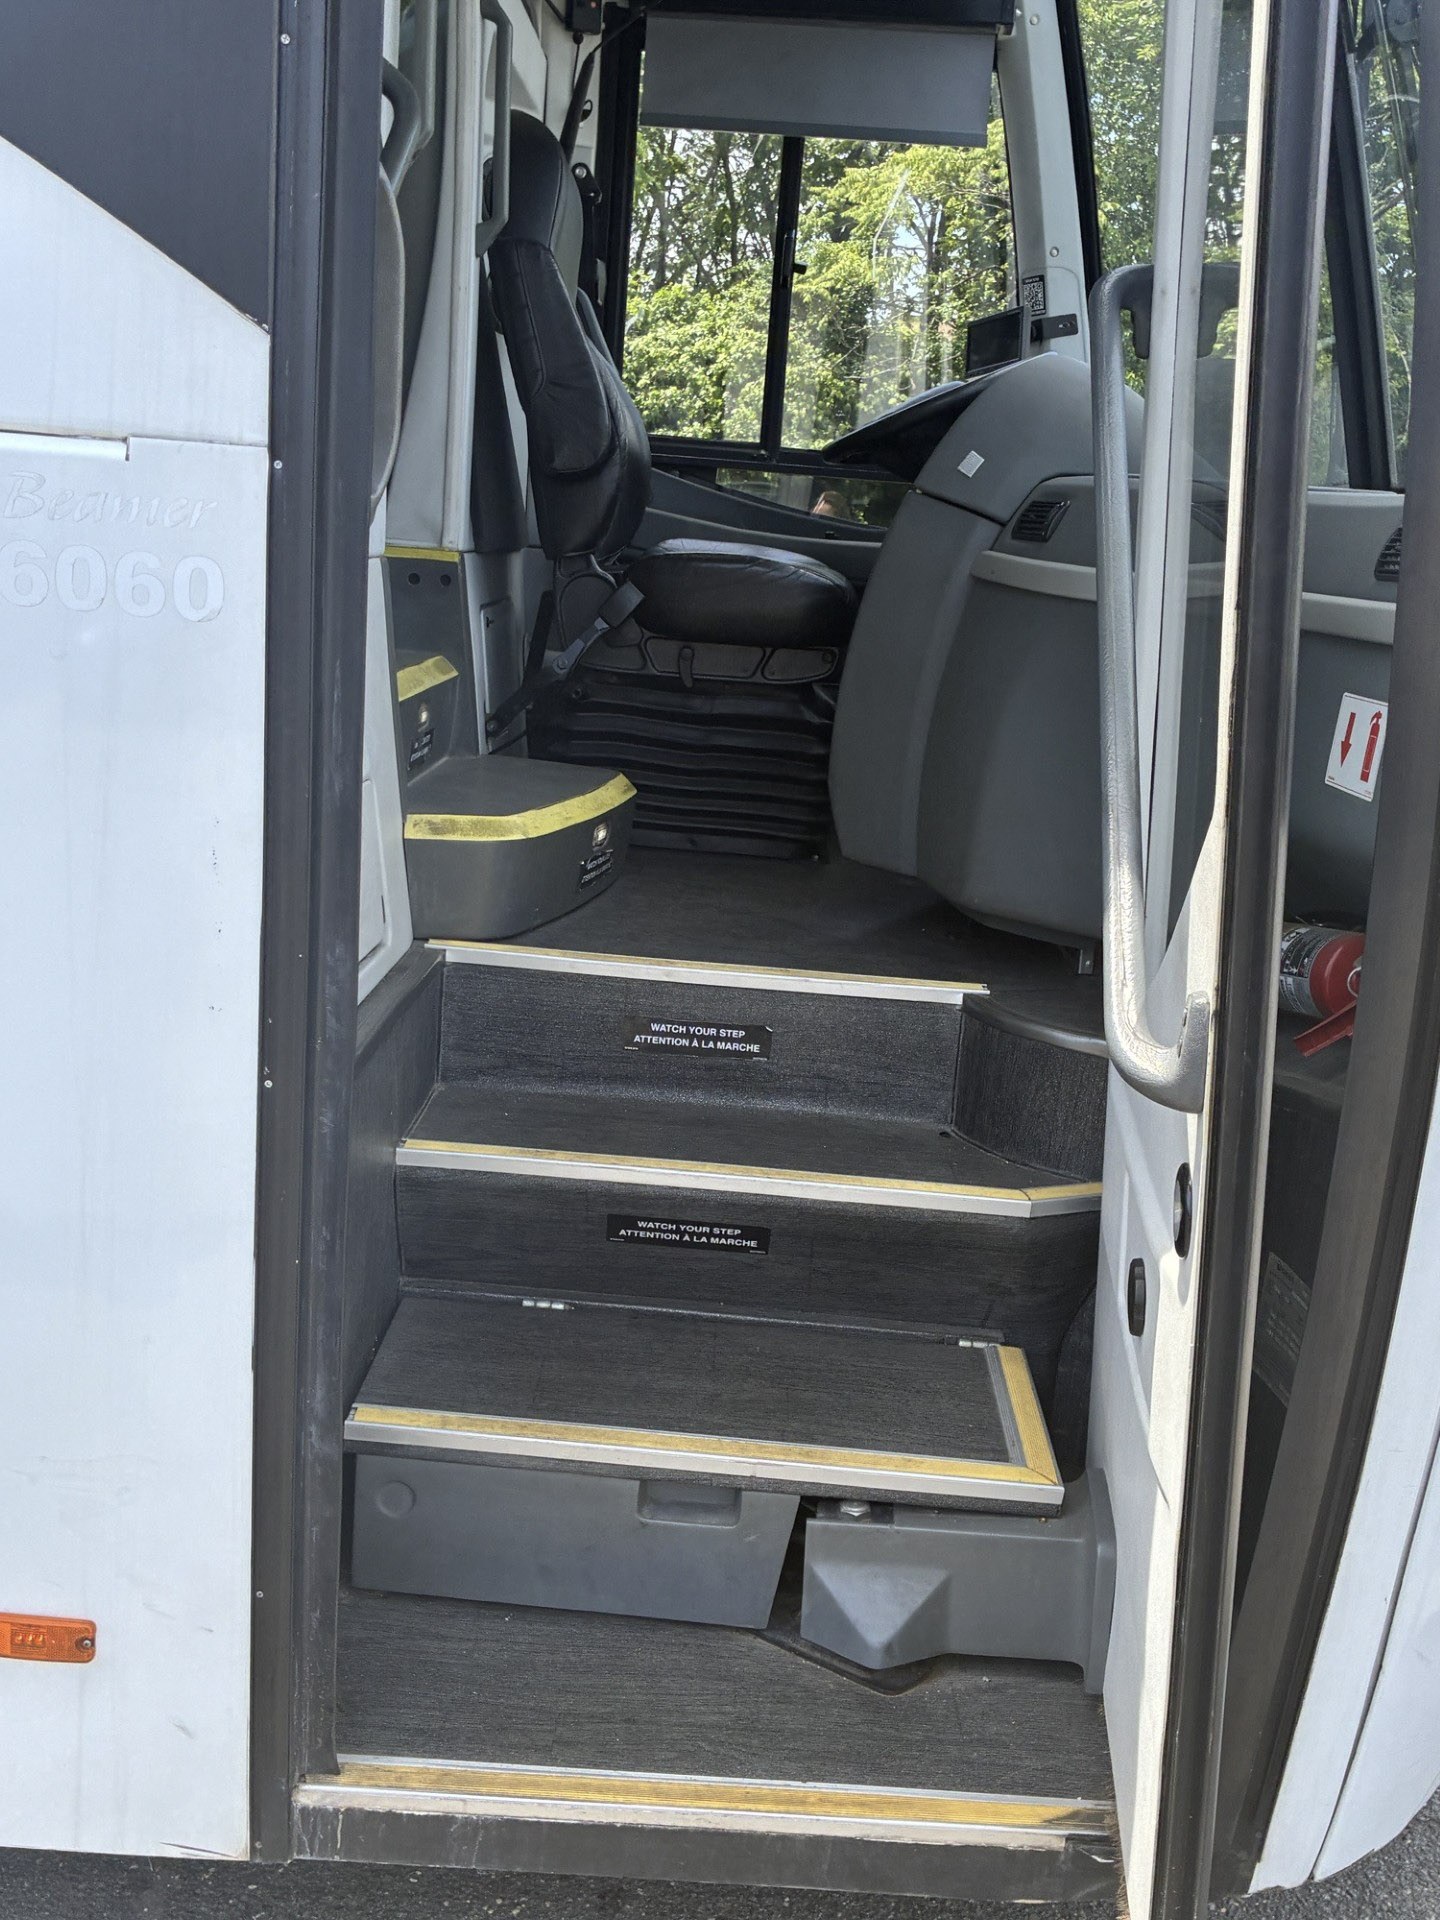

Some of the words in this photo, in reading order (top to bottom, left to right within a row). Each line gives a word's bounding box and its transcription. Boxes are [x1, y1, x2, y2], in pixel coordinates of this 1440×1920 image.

[0, 540, 225, 622] 6060
[650, 1023, 685, 1034] WATCH
[688, 1026, 717, 1037] YOUR
[719, 1029, 746, 1039] STEP
[633, 1035, 690, 1047] ATTENTION
[691, 1038, 699, 1048] À
[701, 1040, 714, 1049] LA
[716, 1042, 760, 1053] MARCHE
[637, 1221, 677, 1231] WATCH
[679, 1224, 711, 1234] YOUR
[713, 1227, 742, 1236] STEP
[618, 1229, 680, 1241] ATTENTION
[682, 1233, 691, 1242] À
[693, 1235, 707, 1243] LA
[710, 1237, 758, 1248] MARCHE
